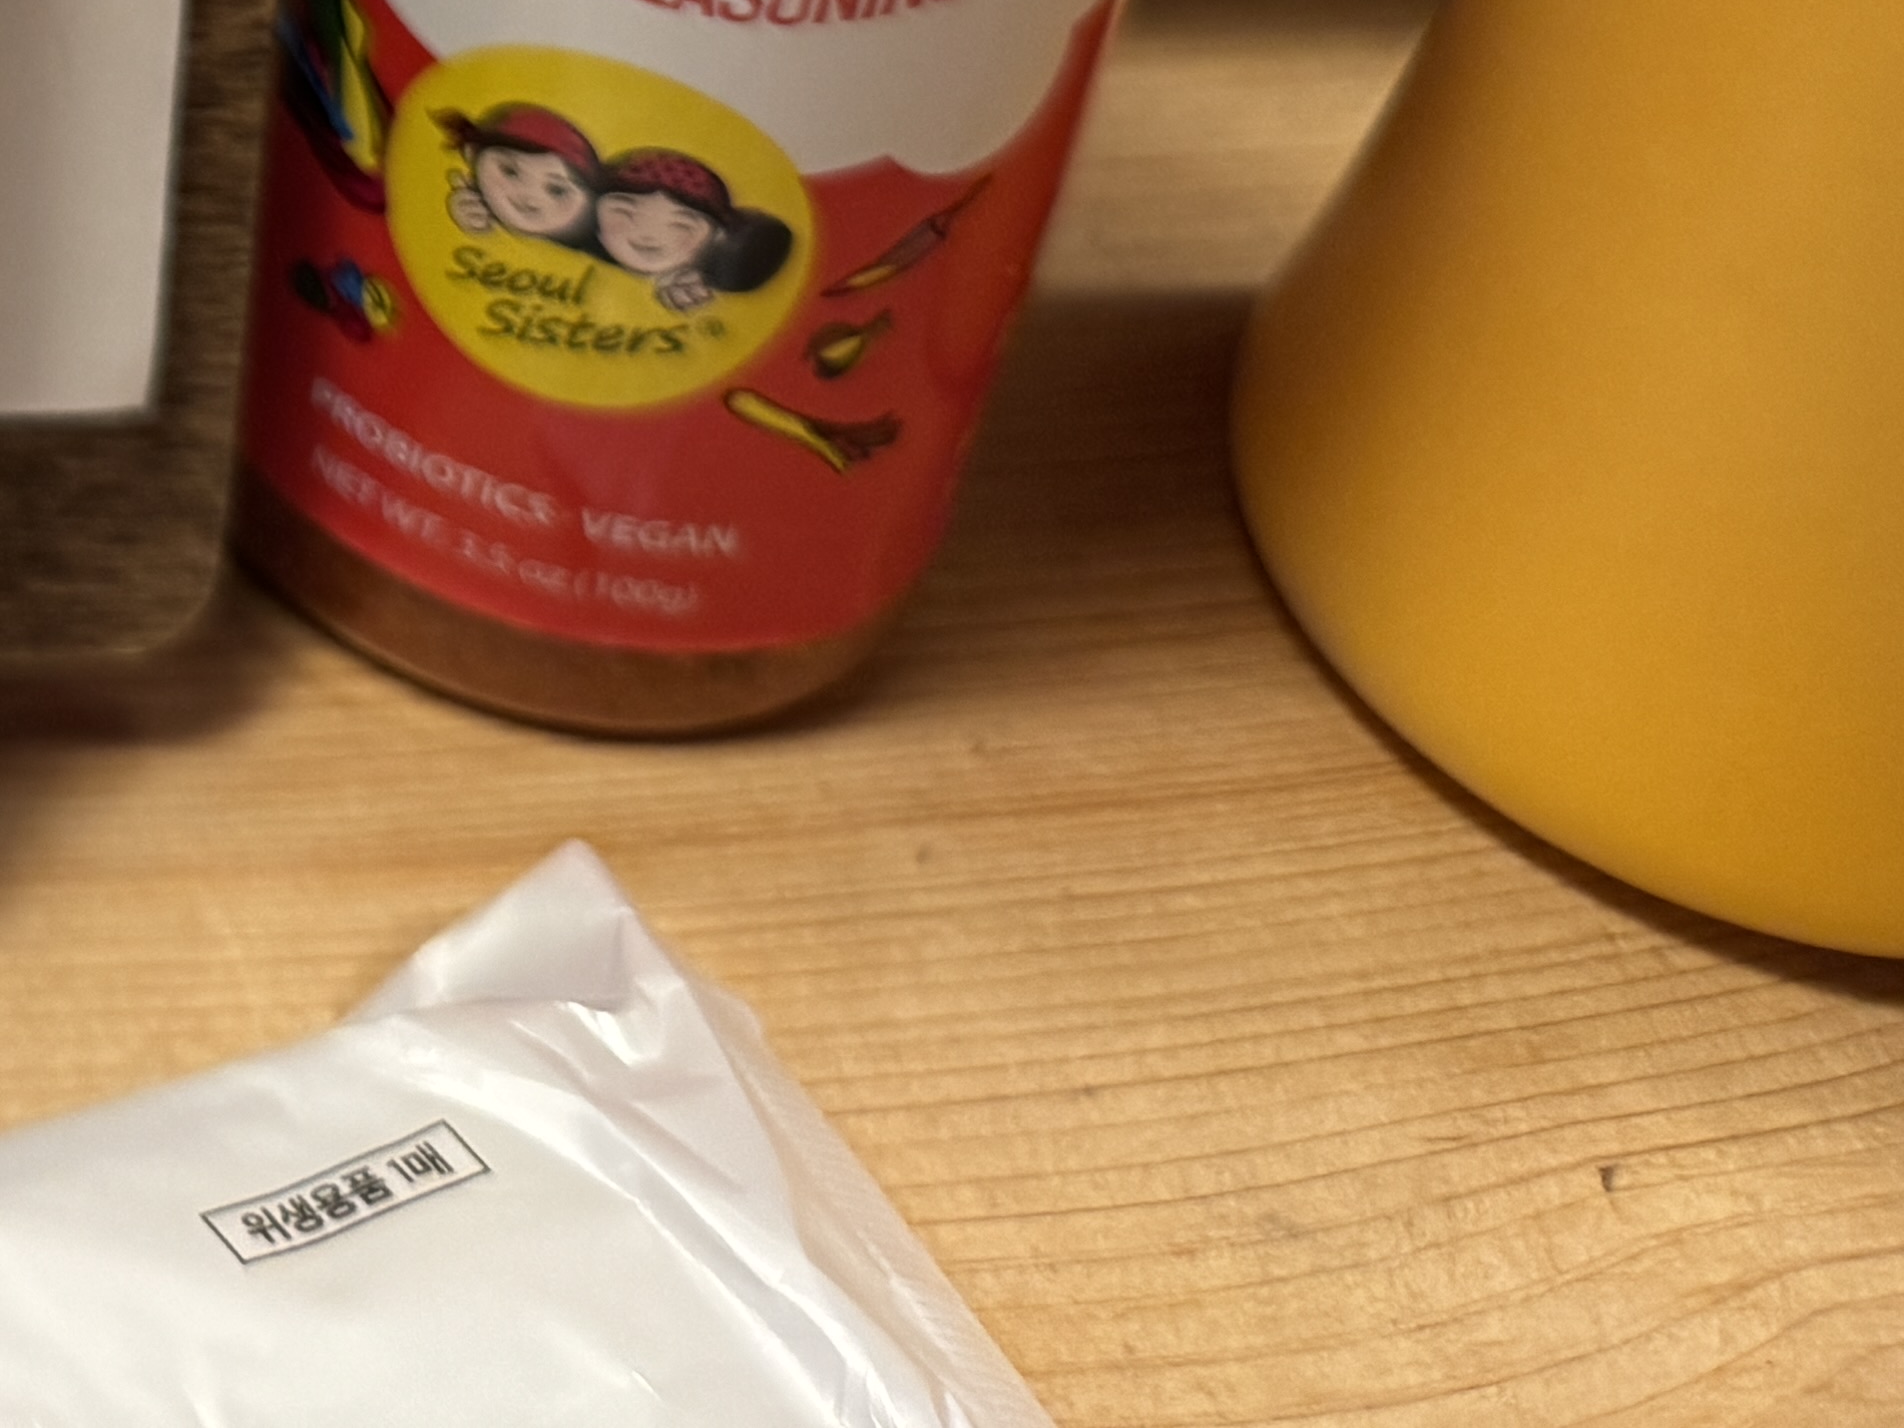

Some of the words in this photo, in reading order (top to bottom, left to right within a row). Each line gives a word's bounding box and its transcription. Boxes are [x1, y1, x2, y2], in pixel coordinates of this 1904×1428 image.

[445, 246, 595, 305] Seoul
[476, 298, 689, 354] Sisters
[582, 507, 738, 554] VEGAN
[241, 1164, 394, 1244] 위생용품
[386, 1140, 454, 1184] 1매
